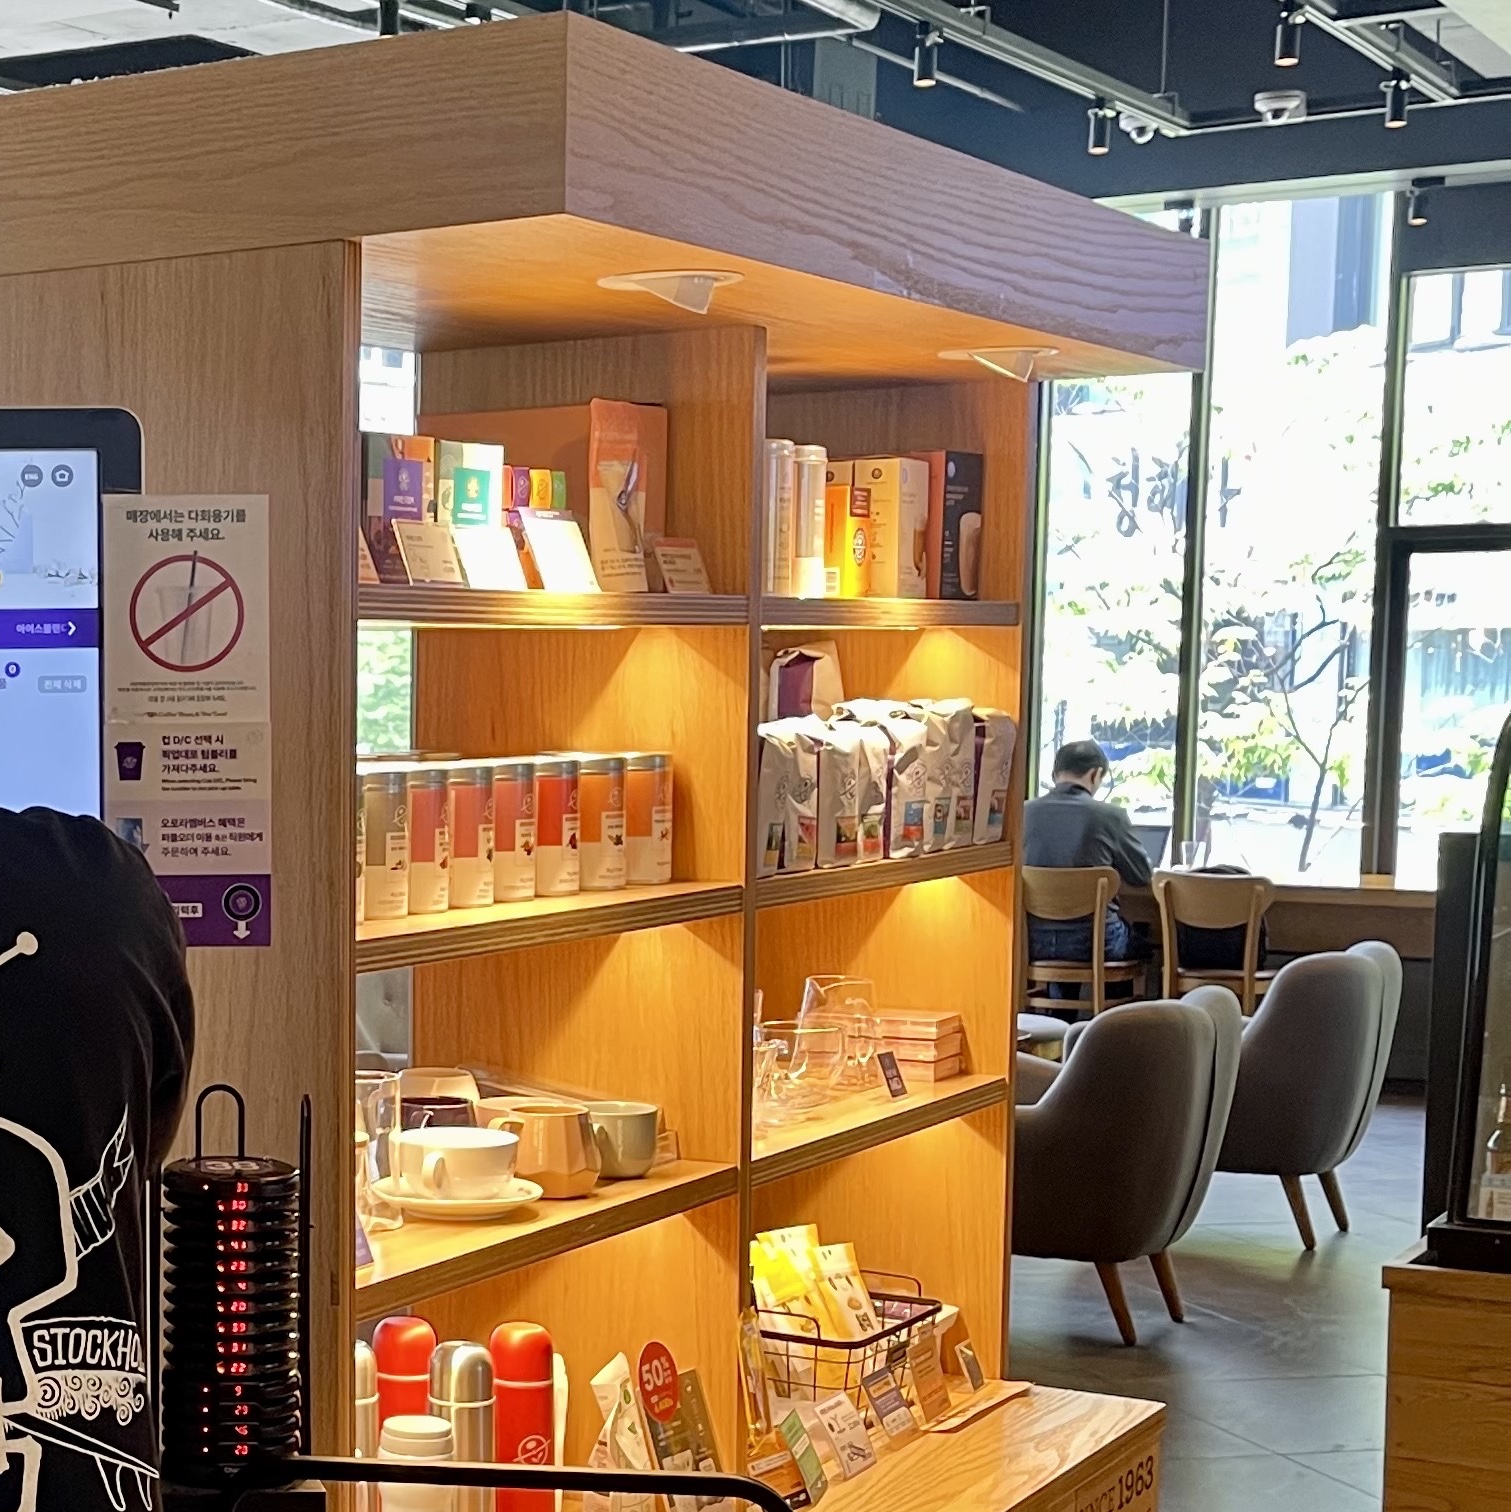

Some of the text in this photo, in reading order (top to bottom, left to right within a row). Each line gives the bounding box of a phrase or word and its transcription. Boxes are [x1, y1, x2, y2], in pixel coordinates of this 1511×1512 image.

[126, 508, 246, 524] 매장에서는 다회용기를
[148, 528, 225, 541] 사용해 주세요.
[162, 735, 224, 746] 컵 D/C 선택 시
[201, 847, 232, 857] 주세요.
[1118, 1454, 1154, 1510] 1963
